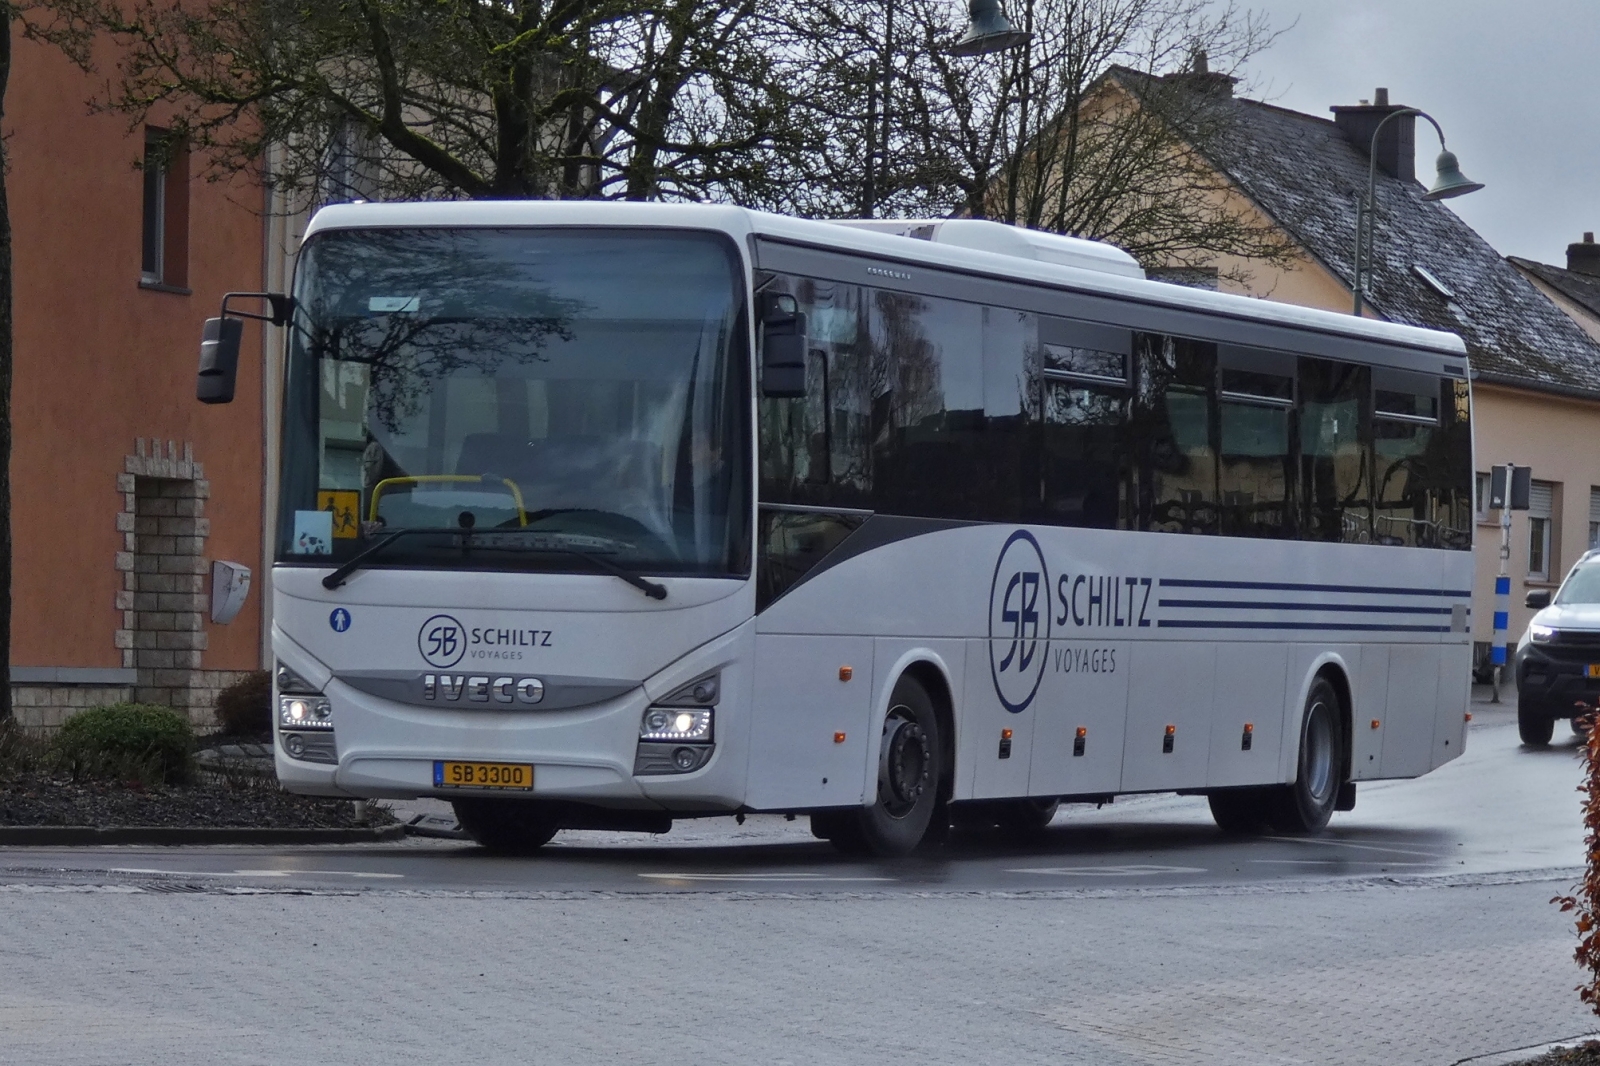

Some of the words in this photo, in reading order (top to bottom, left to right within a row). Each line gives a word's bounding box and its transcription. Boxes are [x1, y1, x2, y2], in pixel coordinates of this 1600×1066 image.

[1056, 573, 1153, 628] SCHILTZ
[1000, 571, 1040, 673] SB
[427, 626, 458, 657] SB
[471, 628, 553, 647] SCHILTZ
[470, 650, 523, 660] VOYAGES
[1055, 648, 1116, 673] VOYAGES
[424, 674, 545, 705] IVECO
[452, 765, 474, 782] SB
[478, 766, 523, 784] 3300
